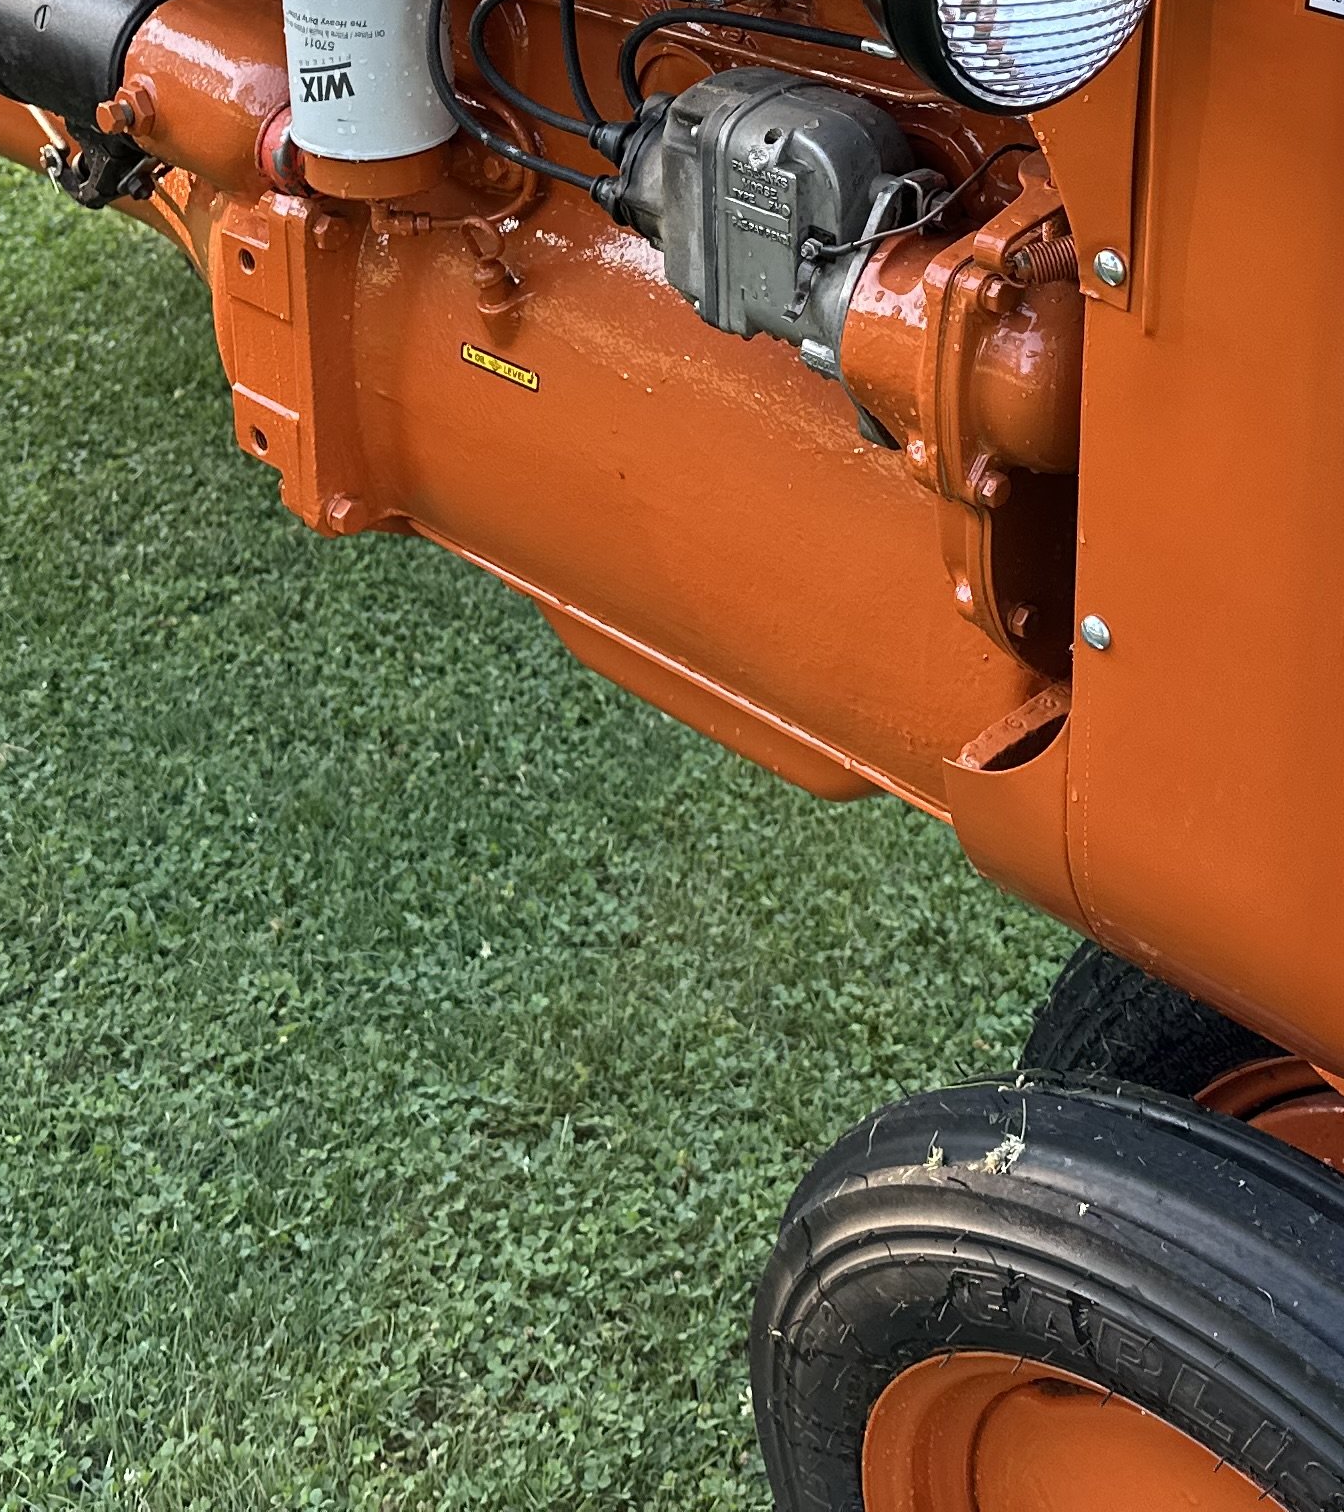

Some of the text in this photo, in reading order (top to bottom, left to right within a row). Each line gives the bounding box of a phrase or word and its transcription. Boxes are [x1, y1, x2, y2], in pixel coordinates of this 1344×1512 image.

[320, 18, 347, 28] Heavy
[350, 20, 368, 28] The
[374, 29, 386, 38] Oil
[303, 37, 335, 52] 57011
[298, 52, 352, 67] FILTERS
[300, 71, 355, 103] WIX
[731, 159, 789, 189] FAIRBANKS
[732, 187, 756, 204] TYPE
[741, 177, 778, 200] MORSE
[503, 366, 526, 383] LEVEL
